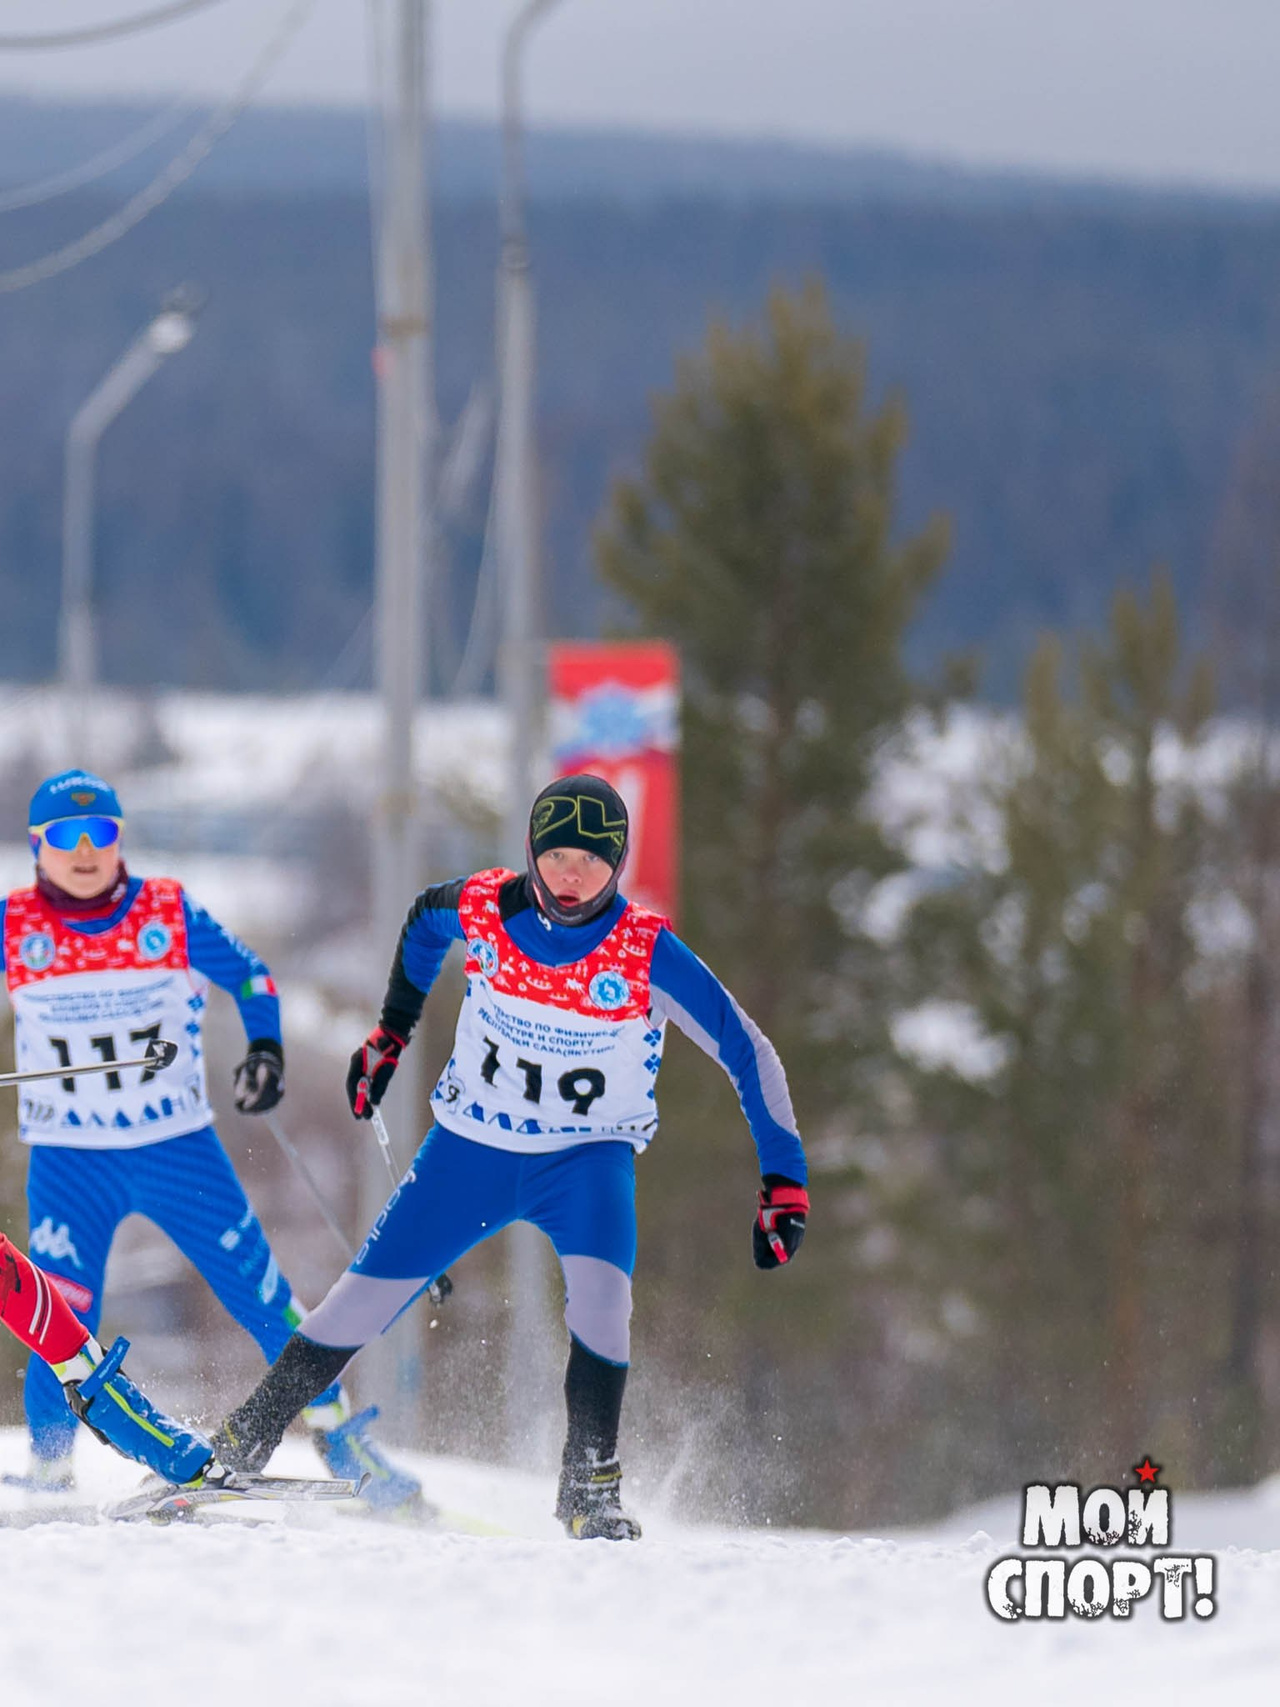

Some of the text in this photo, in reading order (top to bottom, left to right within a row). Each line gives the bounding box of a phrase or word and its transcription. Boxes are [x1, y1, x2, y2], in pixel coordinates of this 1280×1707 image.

[534, 1022, 551, 1033] ПО
[537, 1033, 546, 1042] И
[548, 1036, 594, 1048] СПОРТУ
[48, 1024, 162, 1094] 117
[480, 1035, 606, 1116] 119
